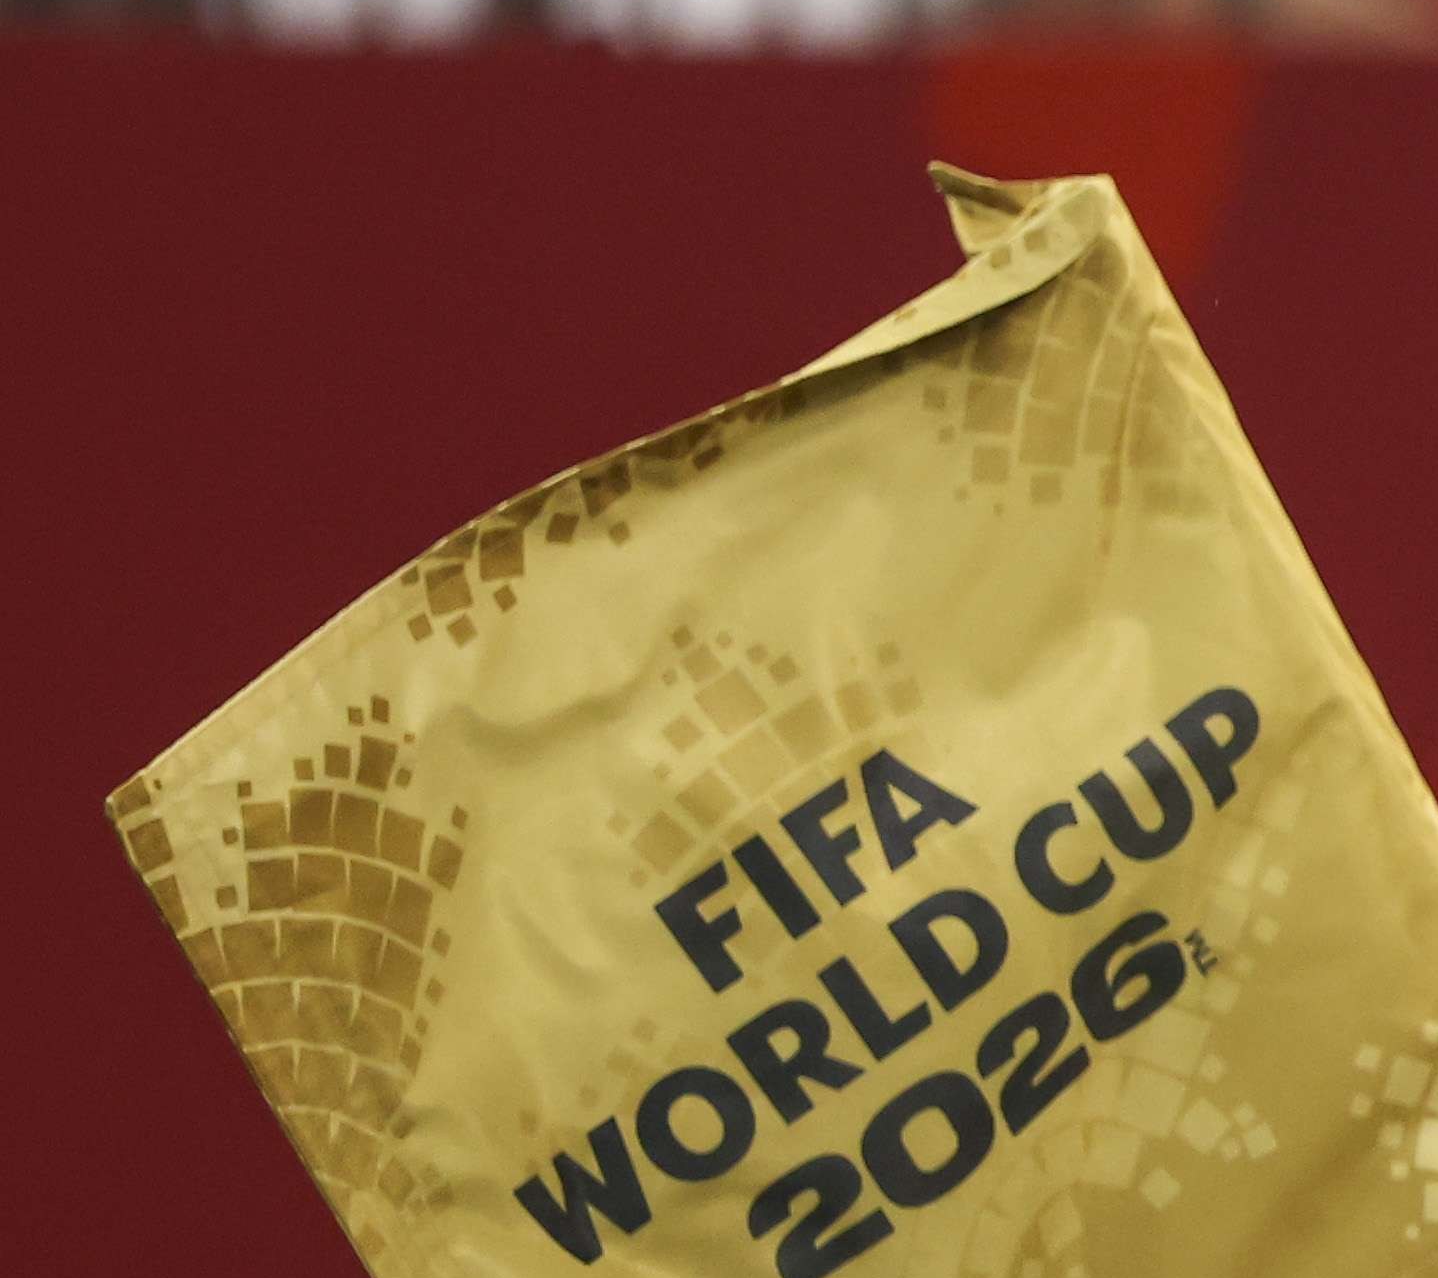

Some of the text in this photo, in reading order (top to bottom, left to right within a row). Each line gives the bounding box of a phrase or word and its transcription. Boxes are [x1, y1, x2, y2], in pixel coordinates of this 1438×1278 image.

[513, 686, 1261, 1265] WORLD CUP
[655, 749, 978, 993] FIFA
